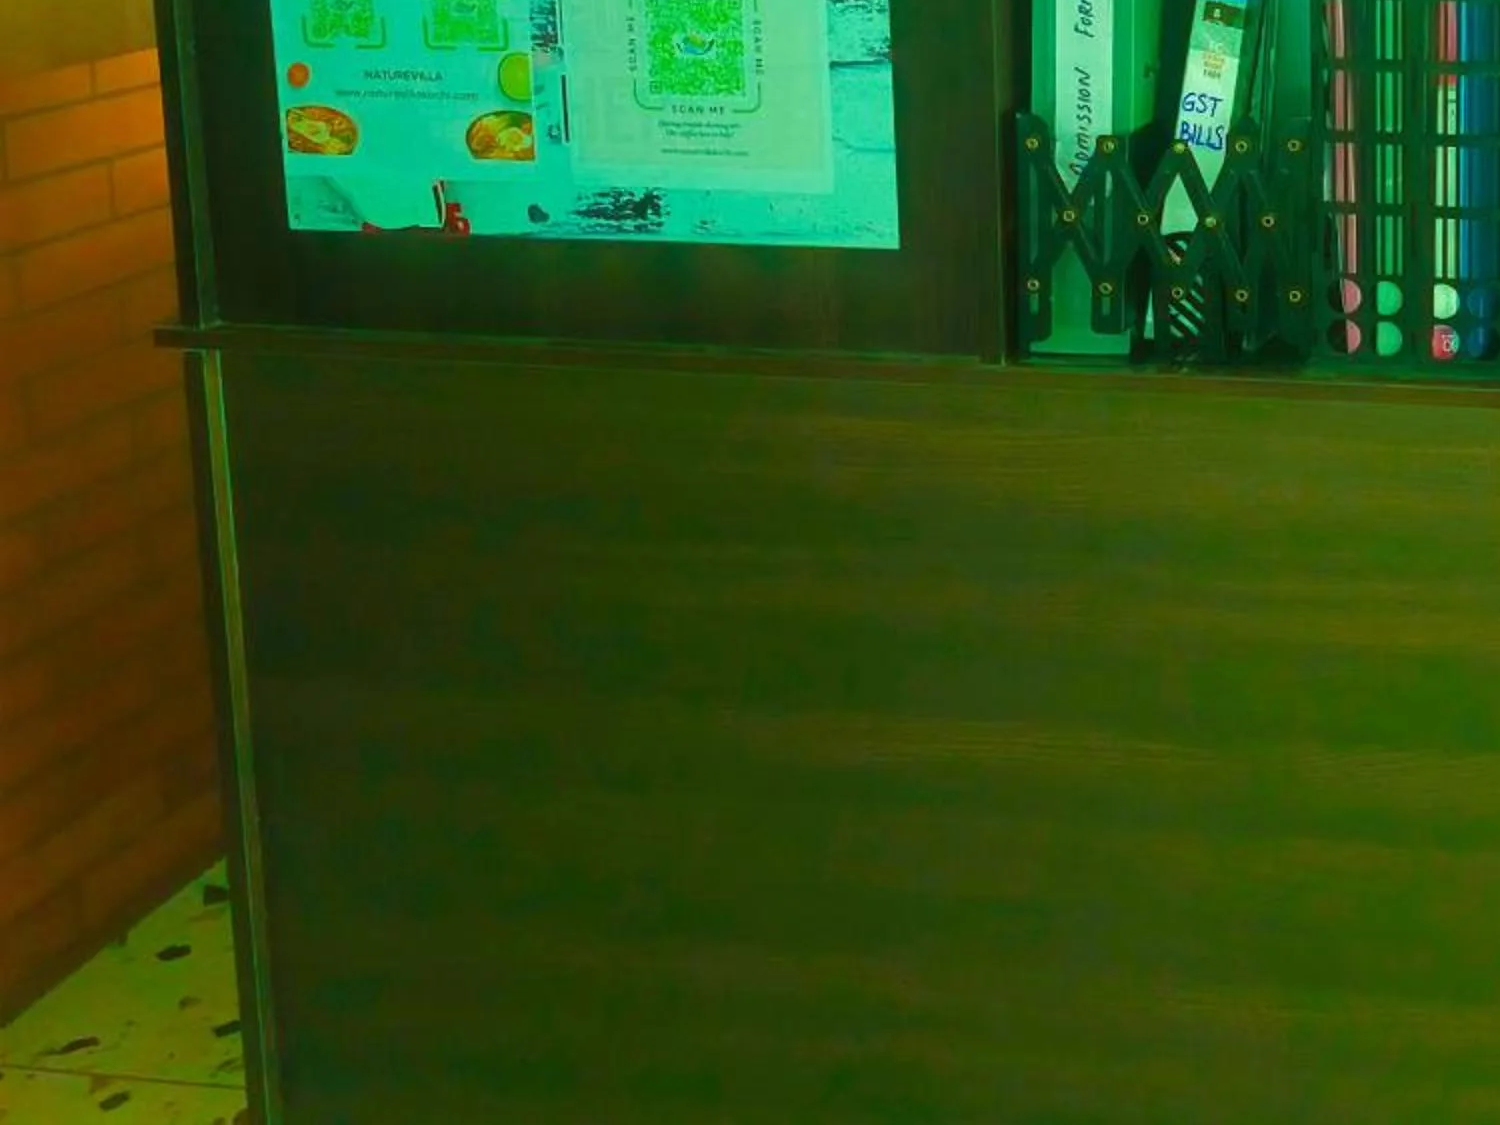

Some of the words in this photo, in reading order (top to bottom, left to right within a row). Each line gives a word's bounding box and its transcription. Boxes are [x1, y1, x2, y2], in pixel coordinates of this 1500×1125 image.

[671, 105, 704, 114] SCAN
[709, 106, 725, 115] ME
[1181, 92, 1224, 118] GST
[1179, 120, 1226, 151] BILLS
